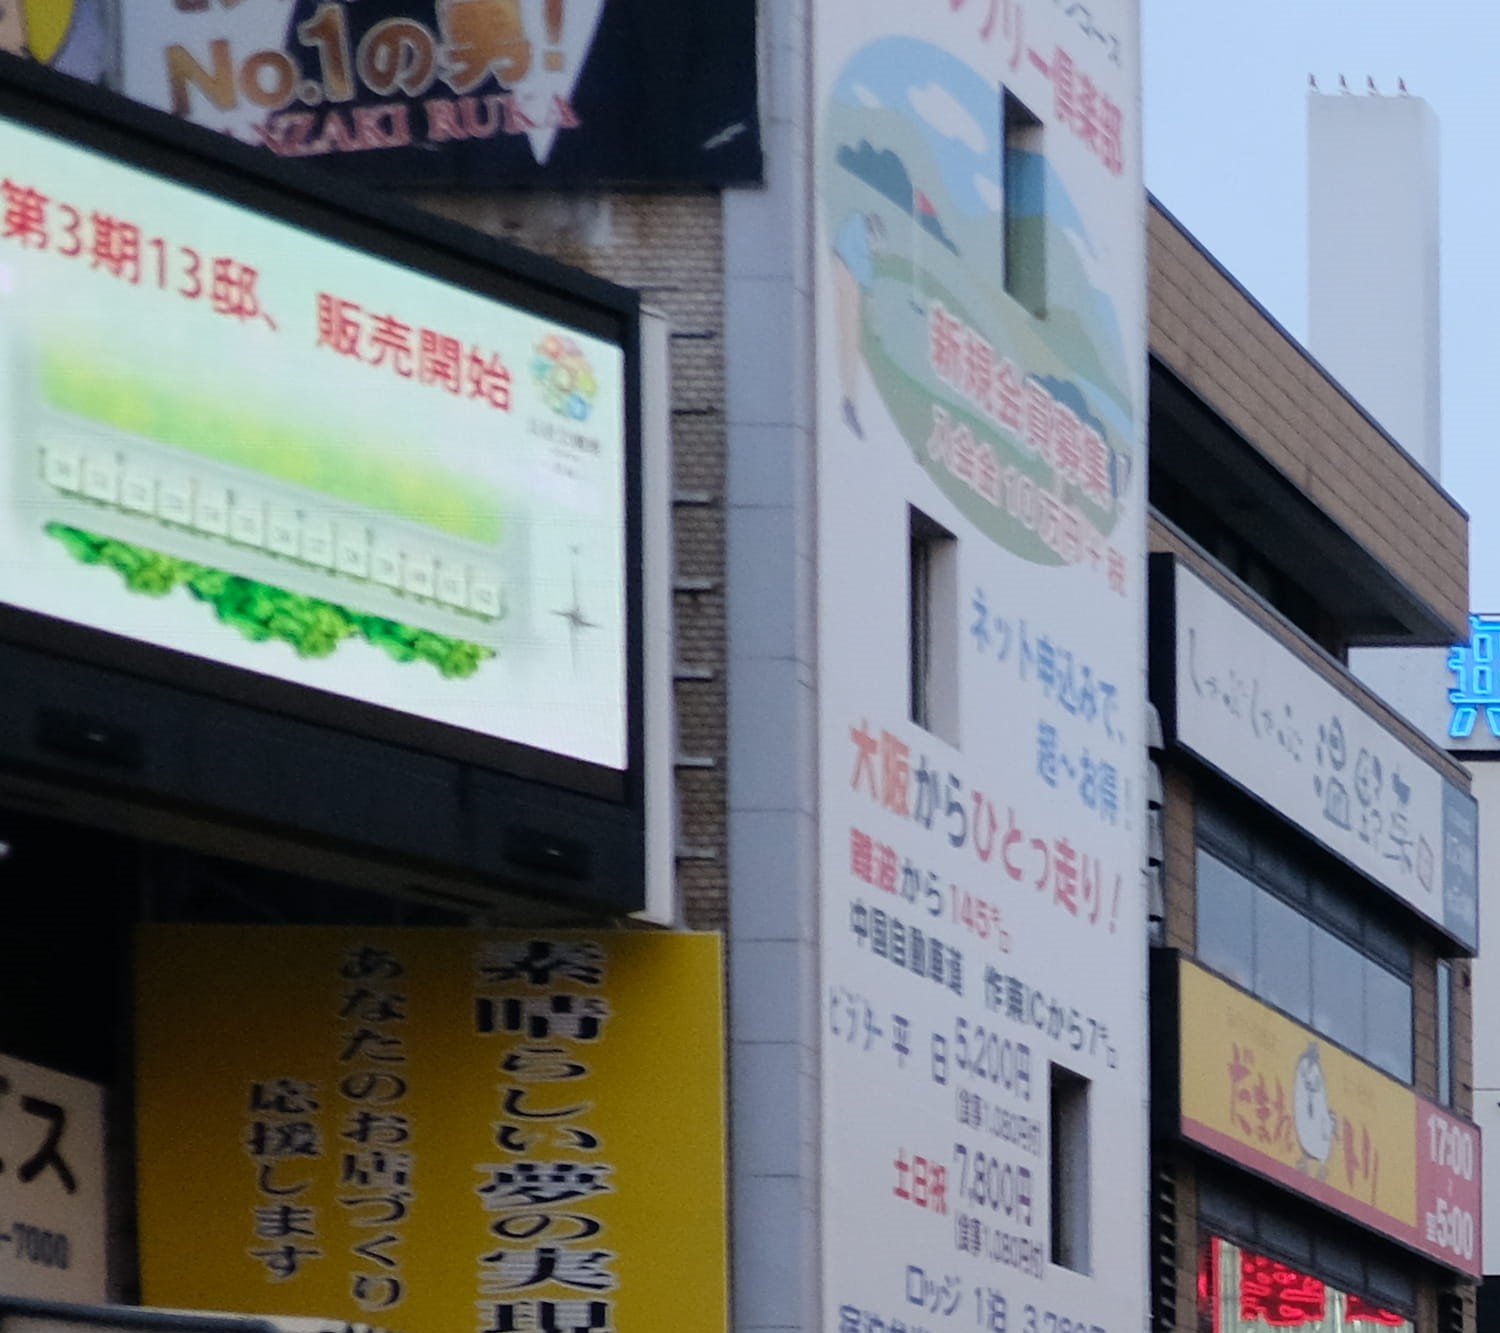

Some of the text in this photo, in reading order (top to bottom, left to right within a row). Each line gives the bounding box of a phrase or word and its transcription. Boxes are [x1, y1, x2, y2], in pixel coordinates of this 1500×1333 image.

[313, 292, 514, 414] 販売開始
[953, 1016, 1033, 1103] 5,200円
[338, 943, 413, 1312] あなたのお店づくり
[1427, 1113, 1473, 1181] 17:00
[247, 1077, 326, 1285] 応援します
[954, 1141, 1035, 1229] 7,800円
[905, 1263, 963, 1318] ロッジ
